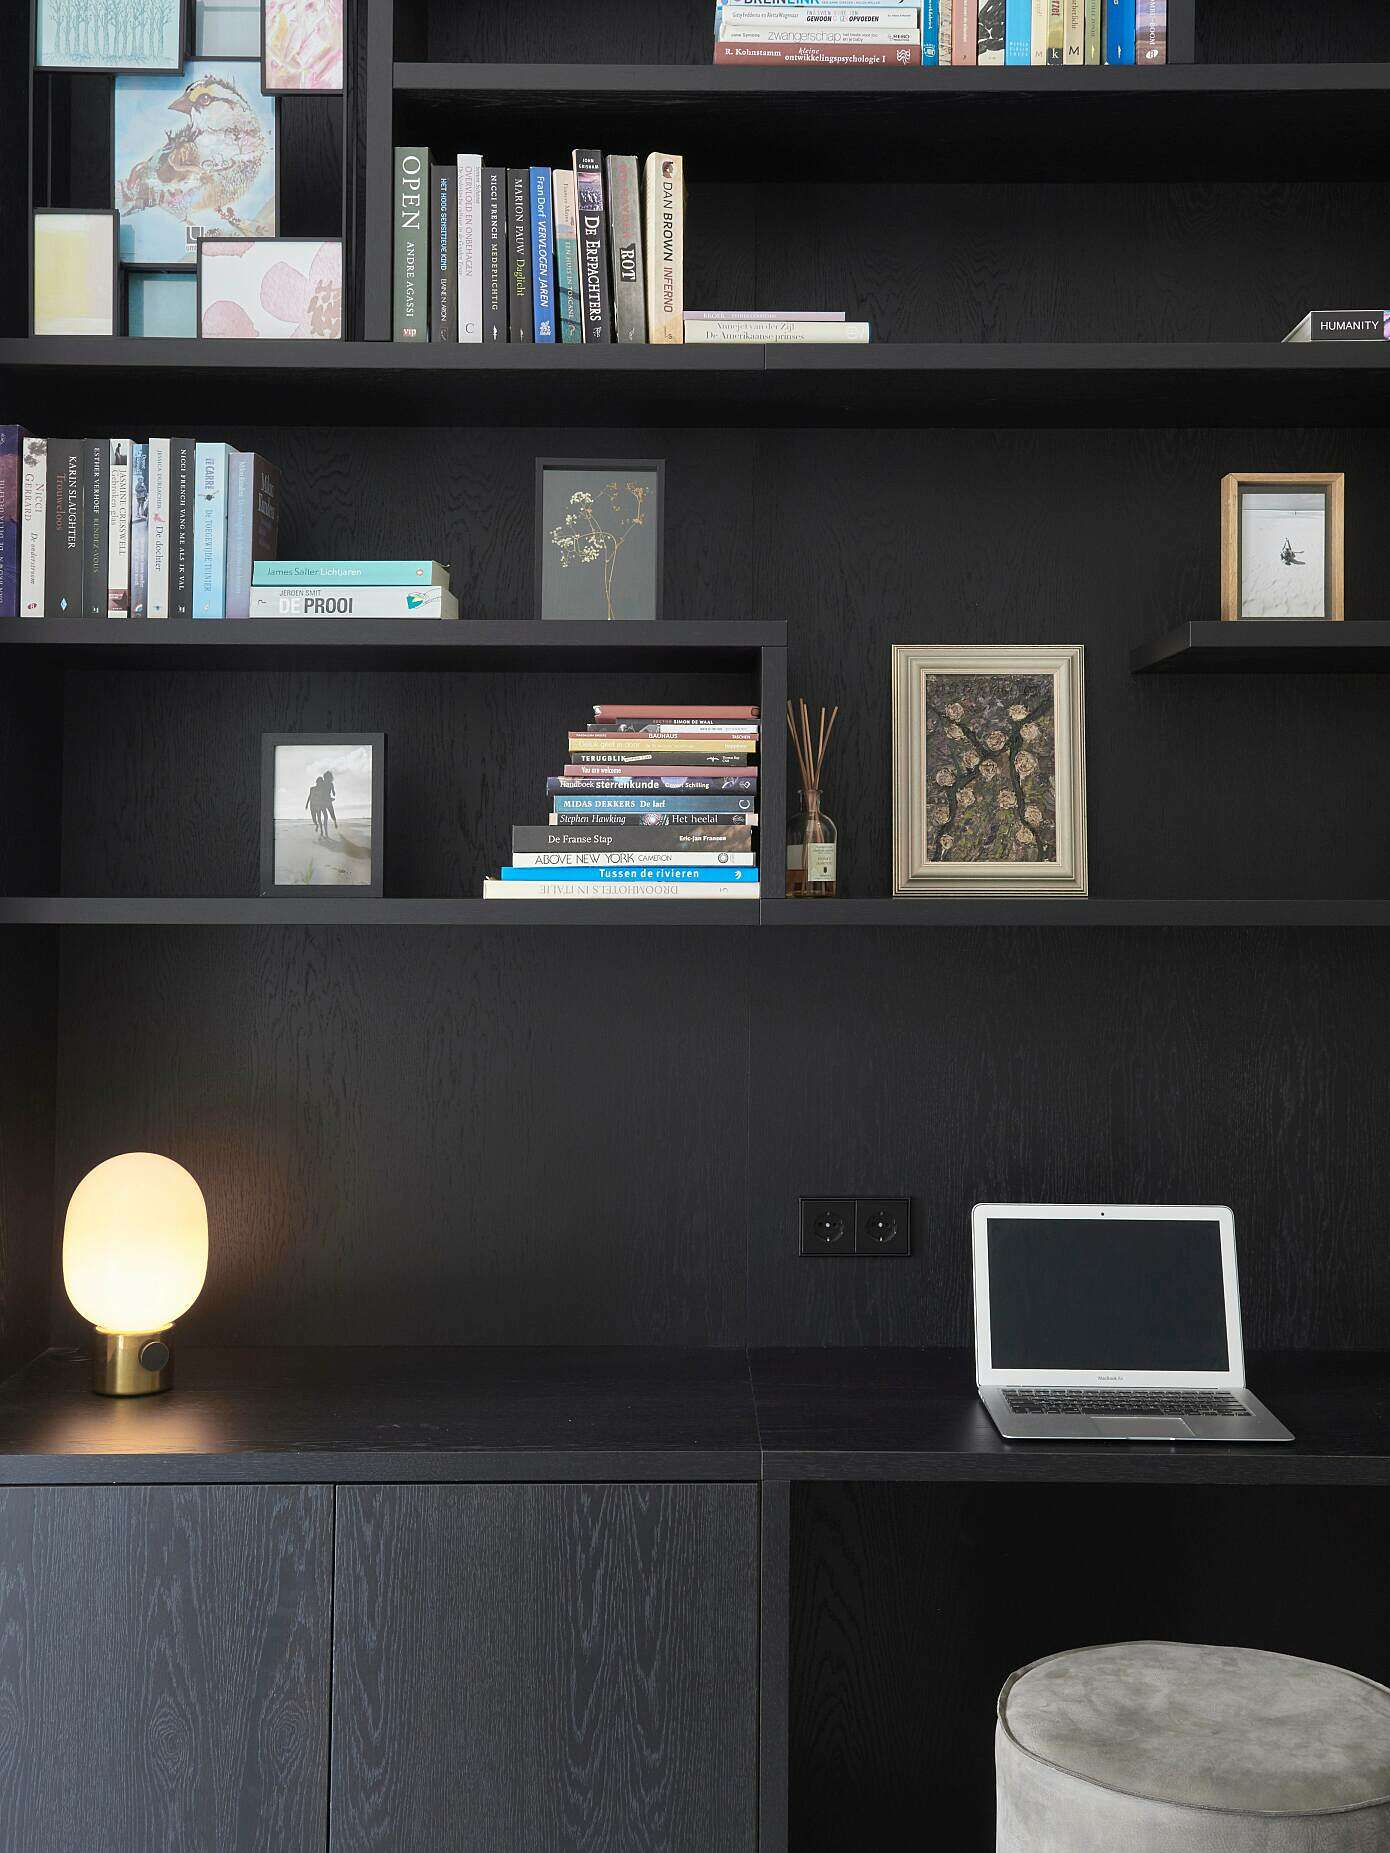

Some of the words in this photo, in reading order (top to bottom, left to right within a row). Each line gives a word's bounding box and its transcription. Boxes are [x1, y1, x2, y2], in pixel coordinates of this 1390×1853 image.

[768, 32, 841, 44] zwangerschap
[784, 54, 880, 64] ontwikkelingspsychologie
[1069, 46, 1080, 55] M
[402, 156, 420, 230] OPEN
[537, 176, 545, 195] Fran
[515, 179, 524, 222] MARION
[664, 182, 672, 209] DAN
[538, 197, 546, 219] Dorf
[465, 215, 472, 225] EN
[584, 216, 599, 235] DE
[516, 226, 524, 254] PAUW
[664, 213, 672, 261] BROWN
[538, 220, 547, 276] VERVLOGEN
[406, 242, 414, 278] ANDRE
[621, 249, 635, 281] ROT
[512, 259, 525, 296] Daglicht
[586, 240, 601, 321] ERFPACHTERS
[406, 281, 414, 316] AGASSI
[539, 278, 548, 307] JAREN
[664, 267, 672, 313] INFERNO
[1320, 320, 1379, 330] HUMANITY
[705, 331, 718, 339] De
[721, 331, 773, 339] Amerikaanse
[775, 332, 805, 341] prinses
[68, 456, 76, 487] KARIN
[24, 473, 34, 522] GERRARD
[35, 483, 44, 512] NICCI
[56, 473, 65, 531] Trouweloos
[68, 490, 76, 549] SLAUGHTER
[110, 511, 118, 526] glas
[31, 533, 37, 542] De
[156, 526, 163, 539] De
[180, 533, 185, 545] ME
[155, 540, 163, 571] dochter
[179, 564, 185, 573] IK
[267, 568, 293, 576] James
[294, 568, 319, 576] Salter
[320, 568, 362, 577] Lichtjaren
[279, 598, 300, 613] DE
[304, 598, 353, 613] PROOI
[560, 780, 594, 788] Handboek
[596, 780, 659, 789] sterrenkunde
[652, 800, 666, 808] larf
[560, 815, 589, 823] Stephen
[592, 815, 626, 824] Hawking
[672, 815, 688, 823] Het
[692, 815, 718, 823] heelal
[548, 835, 560, 843] De
[563, 835, 591, 843] Franse
[594, 835, 613, 845] Stap
[535, 854, 572, 865] ABOVE
[577, 854, 600, 863] NEW
[605, 854, 635, 863] YORK
[600, 869, 637, 878] Tussen
[641, 869, 654, 878] de
[656, 868, 699, 878] rivieren
[580, 886, 589, 894] IN
[592, 886, 678, 895] DROOMHOTELS
